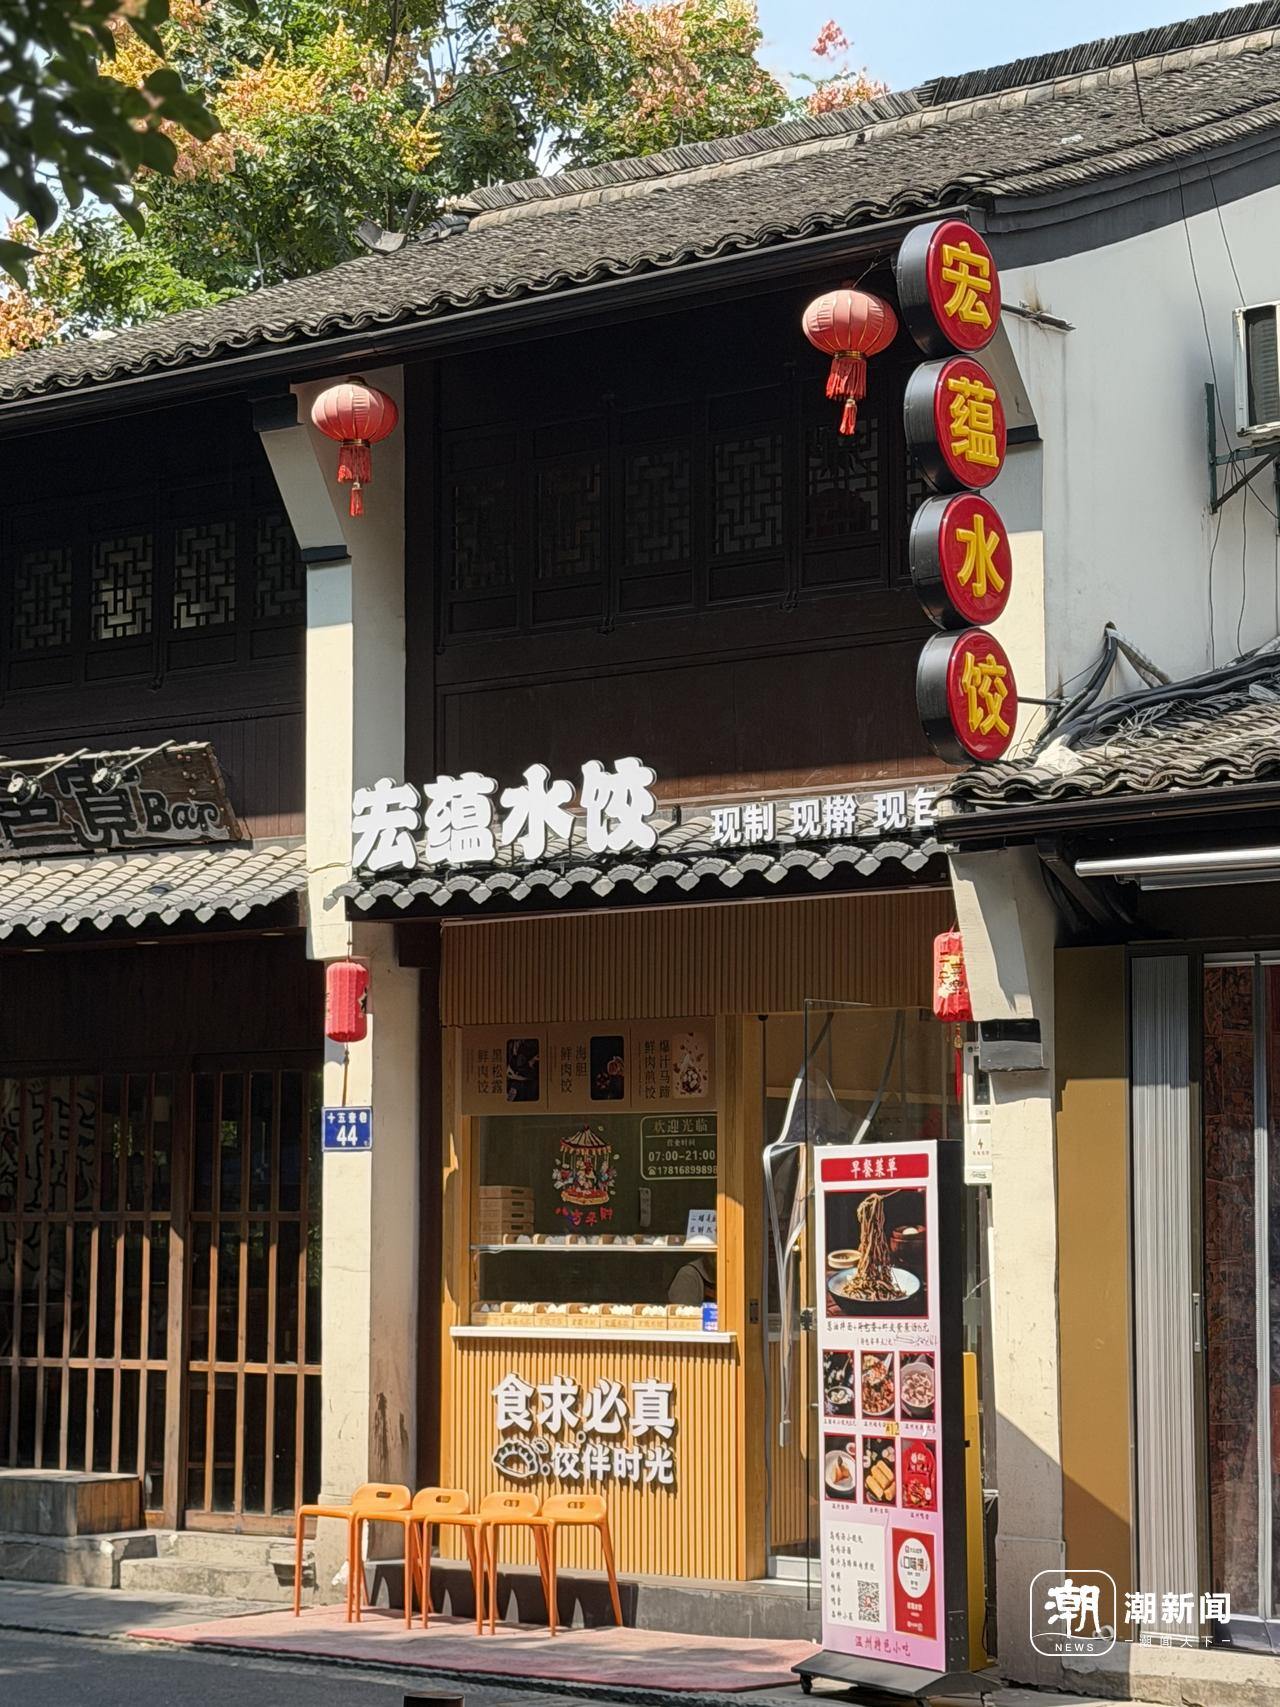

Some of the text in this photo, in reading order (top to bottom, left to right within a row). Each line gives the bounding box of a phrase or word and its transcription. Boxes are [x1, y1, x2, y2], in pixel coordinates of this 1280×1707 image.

[940, 241, 1011, 738] 宏蕴水饺
[141, 789, 221, 834] Bar
[351, 757, 657, 869] 宏蕴水饺
[710, 803, 774, 845] 现制
[789, 795, 857, 837] 现擀
[336, 1125, 358, 1146] 44
[654, 1118, 708, 1133] 欢迎光临
[491, 1372, 676, 1439] 食求必真
[551, 1444, 674, 1484] 饺伴时光
